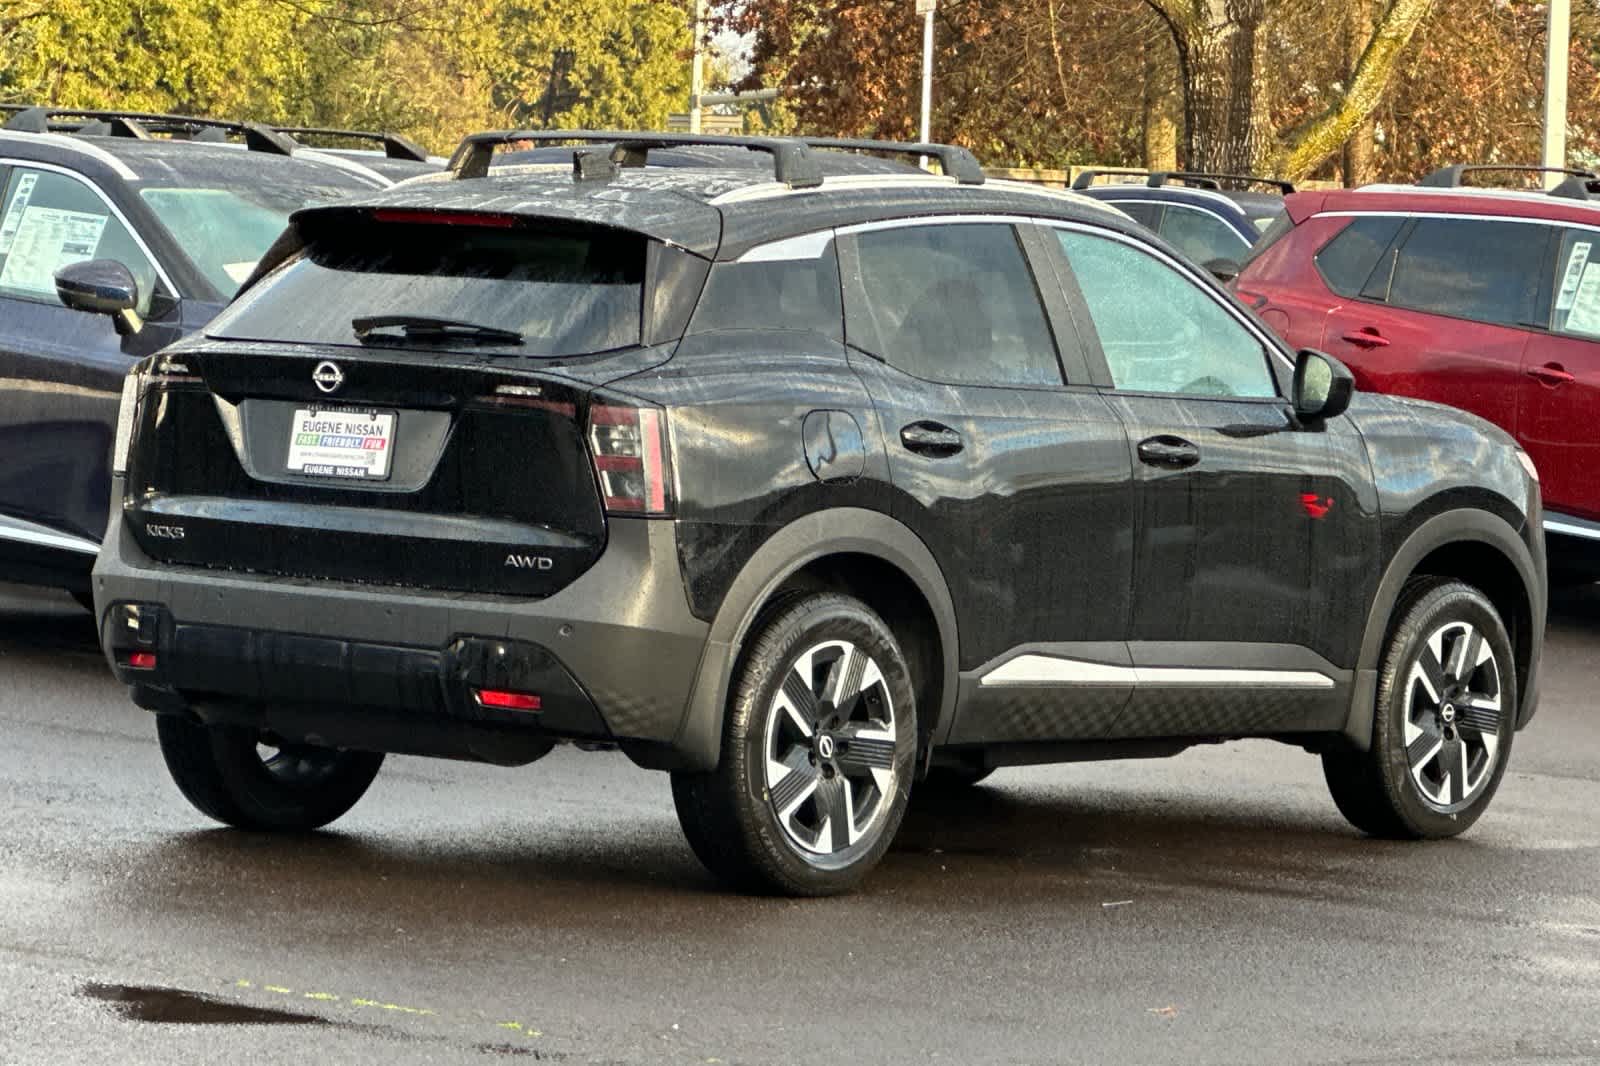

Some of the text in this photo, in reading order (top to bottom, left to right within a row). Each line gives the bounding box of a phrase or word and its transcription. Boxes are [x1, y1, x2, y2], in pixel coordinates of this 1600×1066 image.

[302, 420, 384, 437] EUGENE NISSAN
[304, 464, 365, 478] EUGENE NISSAN
[146, 524, 185, 539] KICKS
[503, 554, 553, 570] AWD
